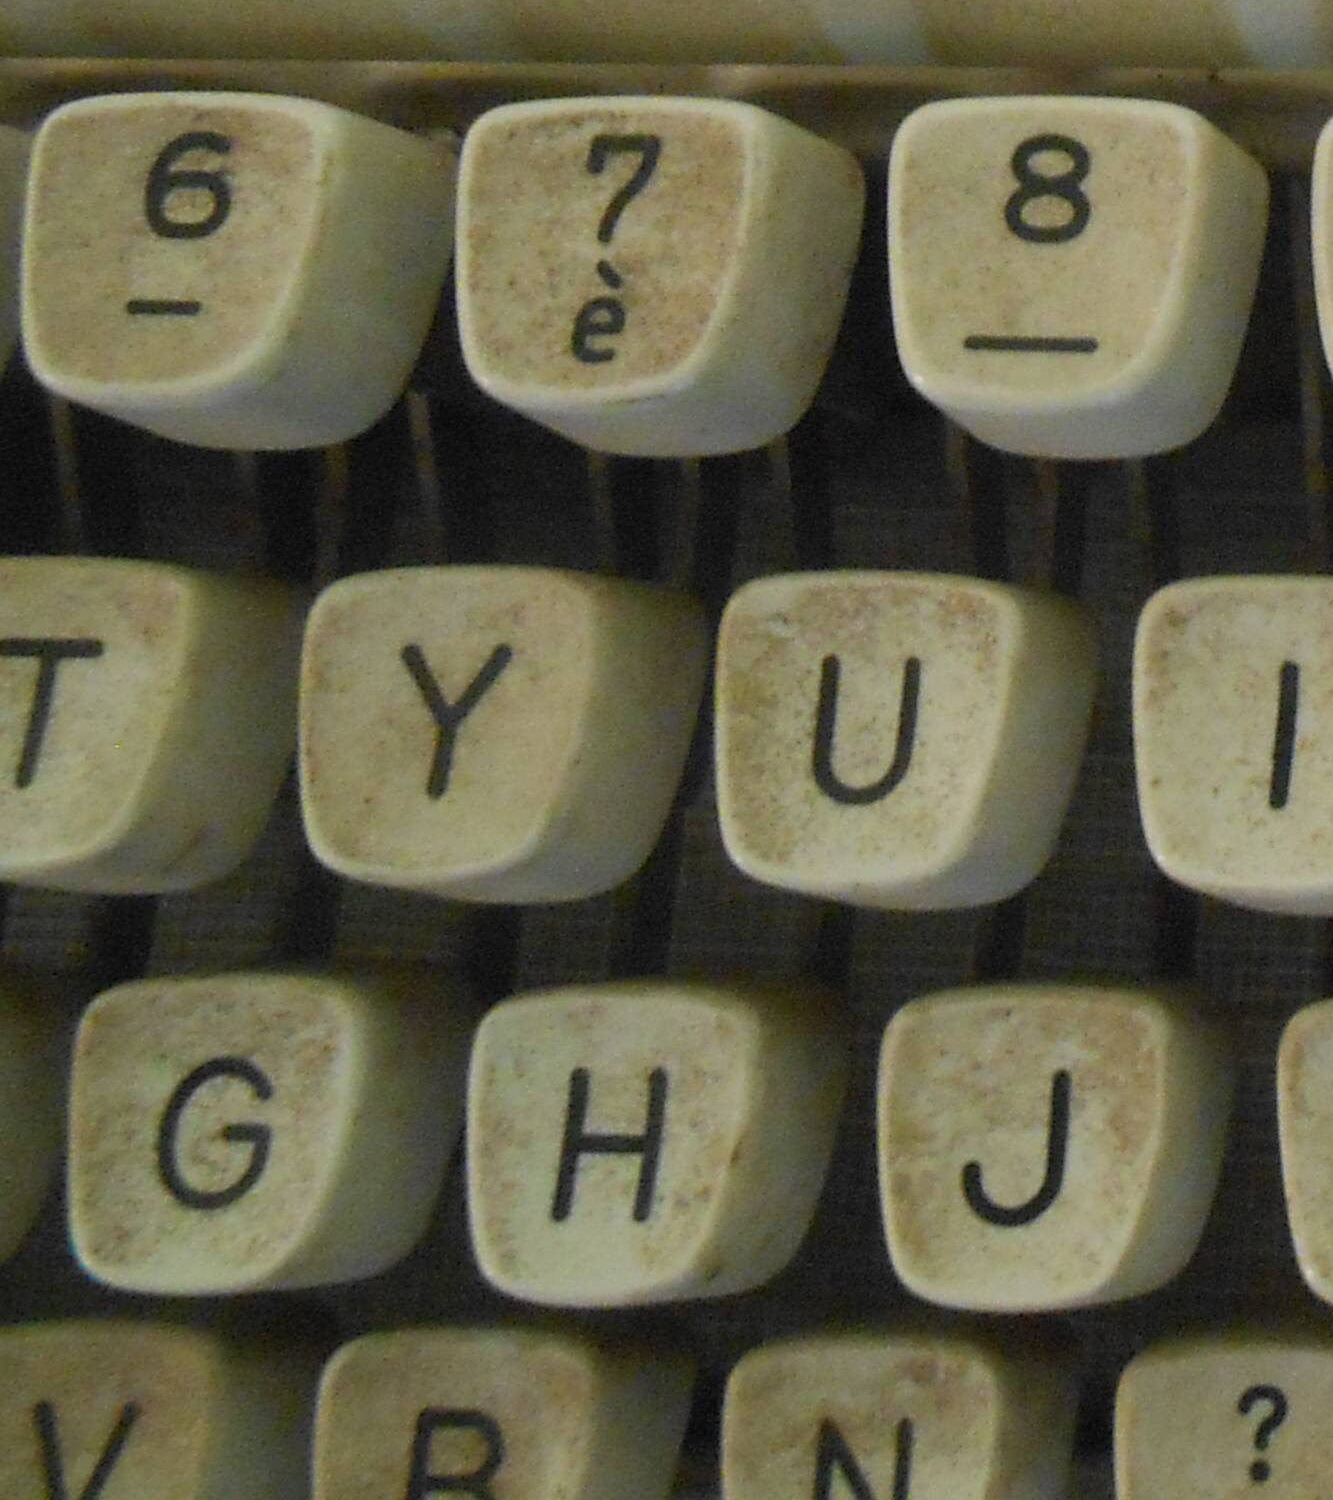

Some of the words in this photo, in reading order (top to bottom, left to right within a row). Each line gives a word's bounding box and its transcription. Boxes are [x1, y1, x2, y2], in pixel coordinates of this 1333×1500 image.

[145, 131, 233, 239] 6
[585, 134, 662, 244] 7
[1004, 134, 1090, 244] 8
[570, 261, 626, 364] è
[0, 637, 104, 788] T
[401, 644, 513, 799] Y
[811, 654, 920, 805] U
[1269, 661, 1299, 809] I
[154, 1056, 272, 1211] G
[551, 1068, 668, 1222] H
[961, 1070, 1071, 1227] J
[1237, 1385, 1288, 1483] ?
